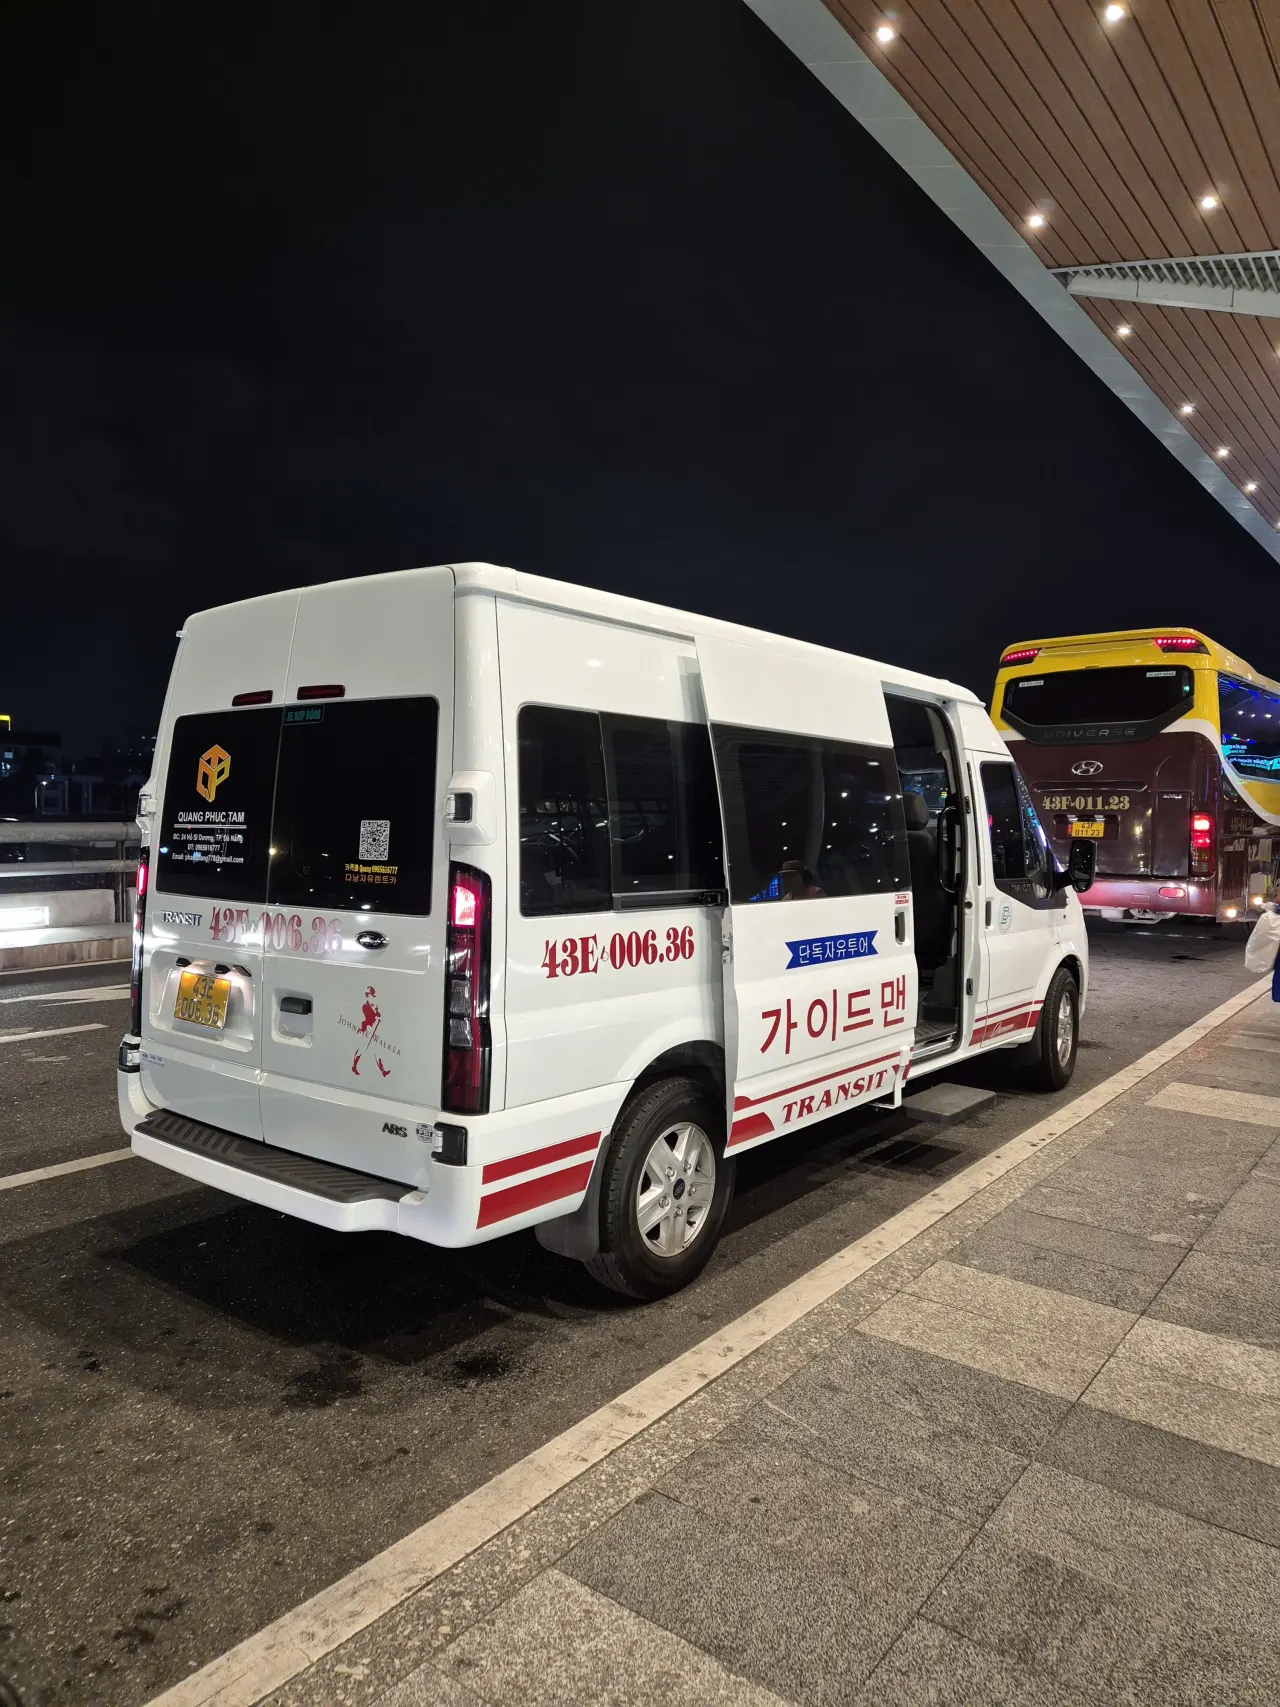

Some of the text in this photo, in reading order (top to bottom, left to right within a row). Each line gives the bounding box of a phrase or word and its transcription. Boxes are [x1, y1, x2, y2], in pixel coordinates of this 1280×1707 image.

[1043, 727, 1137, 739] UNIVERSE
[177, 811, 204, 823] QUANG
[161, 909, 202, 926] TRANSIT
[798, 936, 869, 964] 단독자유투어
[192, 977, 215, 999] 43E
[180, 997, 220, 1025] 006.36
[760, 974, 906, 1055] 가이드맨
[781, 1069, 888, 1124] TRANSIT
[381, 1121, 408, 1138] ABS
